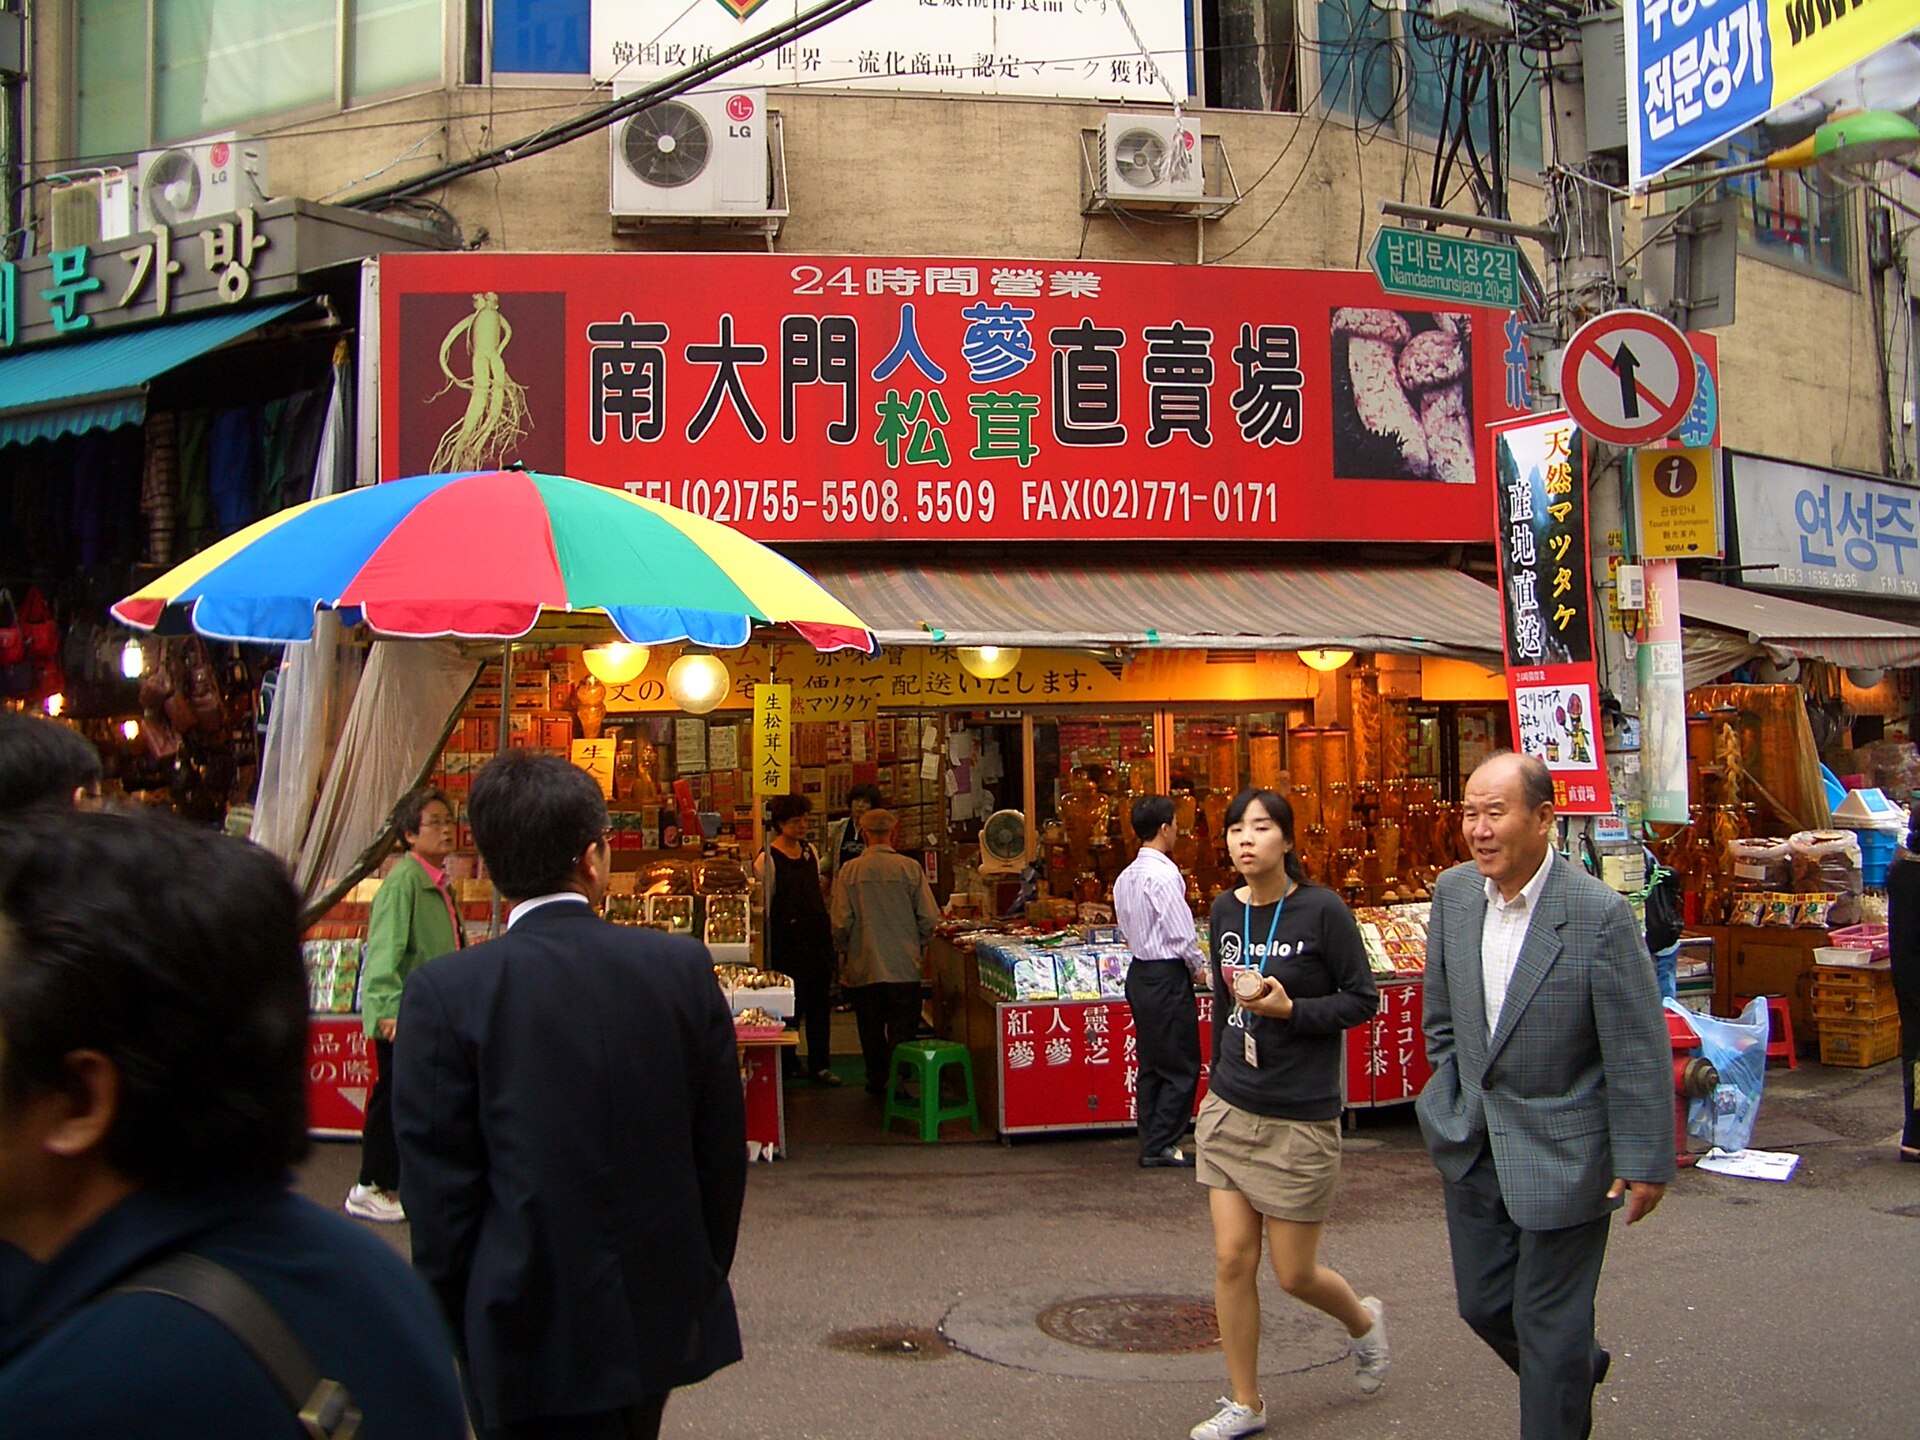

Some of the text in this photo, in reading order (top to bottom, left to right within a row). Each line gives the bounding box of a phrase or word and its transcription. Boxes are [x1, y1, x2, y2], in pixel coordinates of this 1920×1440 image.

[1643, 4, 1764, 141] 전문상가
[211, 170, 228, 185] LG
[729, 126, 752, 138] LG
[1387, 236, 1512, 281] 남대문시장2길
[1390, 265, 1482, 300] Namdaemunsijang
[1022, 478, 1277, 523] FAX(02)771-0171
[1544, 427, 1577, 632] 天然マツタケ
[1794, 483, 1920, 575] 연성주
[1507, 478, 1543, 659] 産地直送
[763, 693, 783, 789] 生松茸入荷
[1396, 985, 1417, 1098] チョコレート
